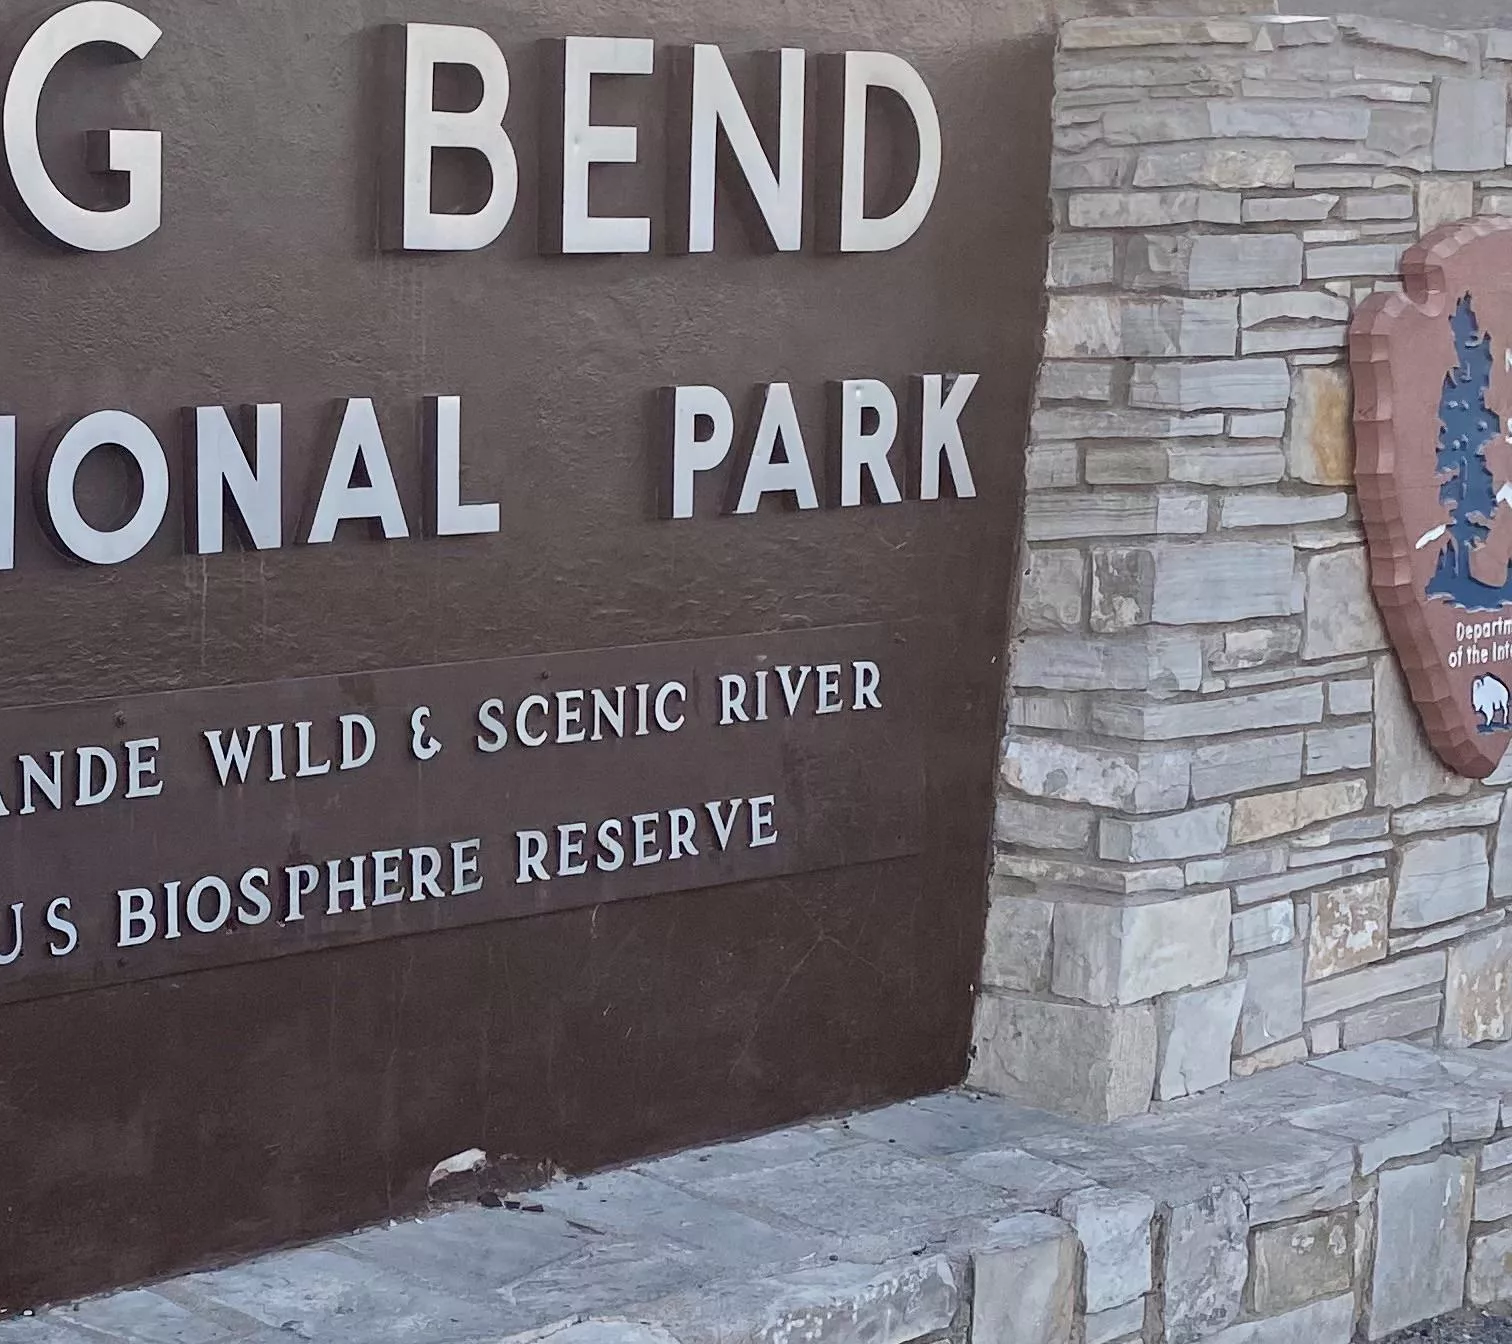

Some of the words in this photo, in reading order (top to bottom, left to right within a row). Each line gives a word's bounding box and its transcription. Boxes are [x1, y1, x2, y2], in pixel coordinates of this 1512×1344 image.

[402, 22, 943, 254] BEND
[672, 372, 980, 519] PARK
[203, 712, 377, 787] WILD
[410, 706, 442, 760] &
[476, 680, 687, 753] SCENIC
[718, 659, 882, 725] RIVER
[1448, 644, 1464, 668] of
[1466, 644, 1489, 665] the
[116, 837, 484, 947] BIOSPHERE
[515, 794, 778, 884] RESERVE
